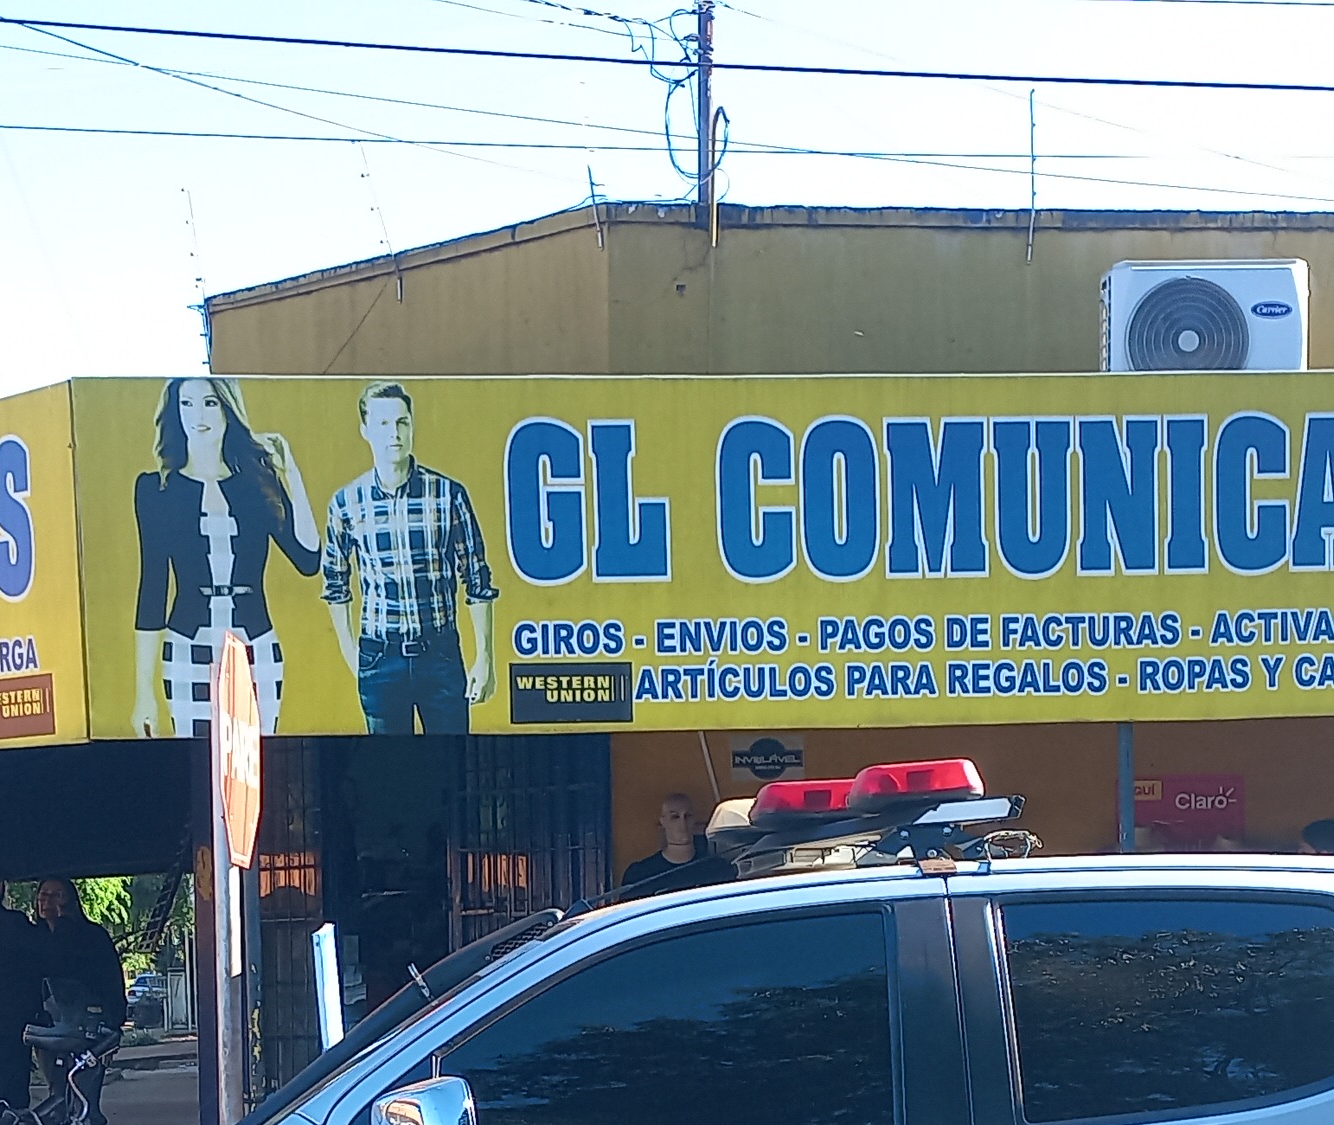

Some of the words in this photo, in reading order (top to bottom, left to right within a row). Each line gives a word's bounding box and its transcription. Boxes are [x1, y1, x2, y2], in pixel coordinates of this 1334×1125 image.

[508, 418, 671, 585] GL
[514, 622, 624, 655] GIROS
[656, 619, 787, 654] ENVIOS
[819, 616, 935, 651] PAGOS
[945, 616, 991, 649] DE
[1001, 613, 1181, 648] FACTURAS
[516, 675, 610, 690] WESTERN
[635, 660, 835, 700] ARTÍCULOS
[847, 663, 937, 697] PARA
[948, 660, 1109, 695] REGALOS
[1139, 656, 1250, 692] ROPAS
[1261, 656, 1283, 688] Y
[1, 702, 41, 718] UNION
[545, 689, 610, 702] UNION
[220, 713, 259, 789] PARE
[1175, 792, 1228, 810] Claro
